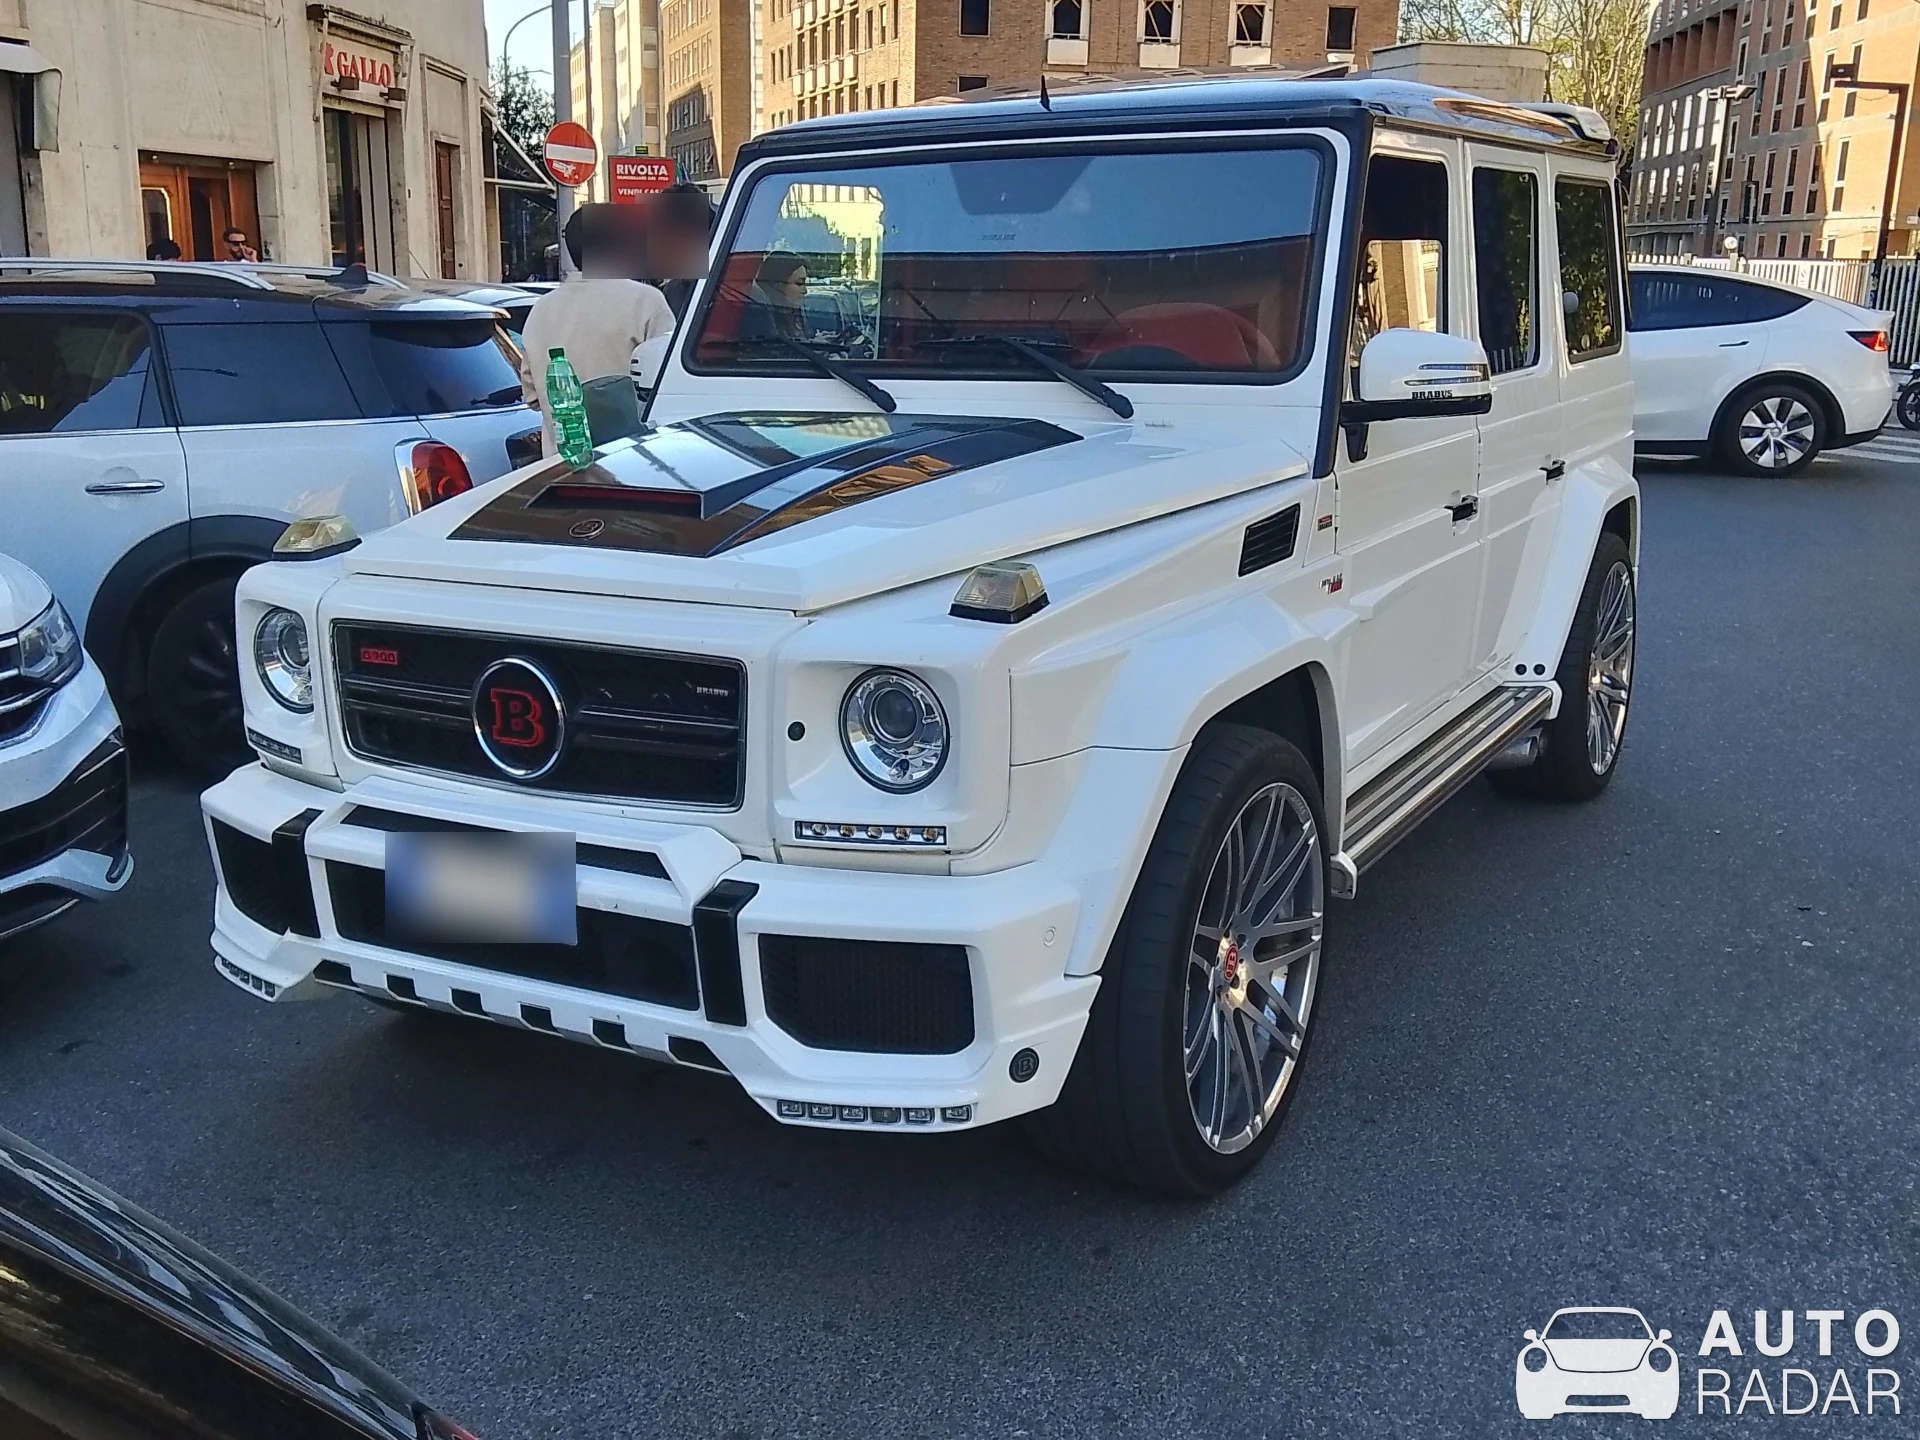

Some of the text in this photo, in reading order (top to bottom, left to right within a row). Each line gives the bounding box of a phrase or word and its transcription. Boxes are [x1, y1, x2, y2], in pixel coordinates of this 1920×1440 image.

[337, 51, 391, 88] GALLO
[616, 164, 669, 176] RIVOLTA
[1411, 390, 1453, 400] BRABUS
[490, 688, 545, 747] B
